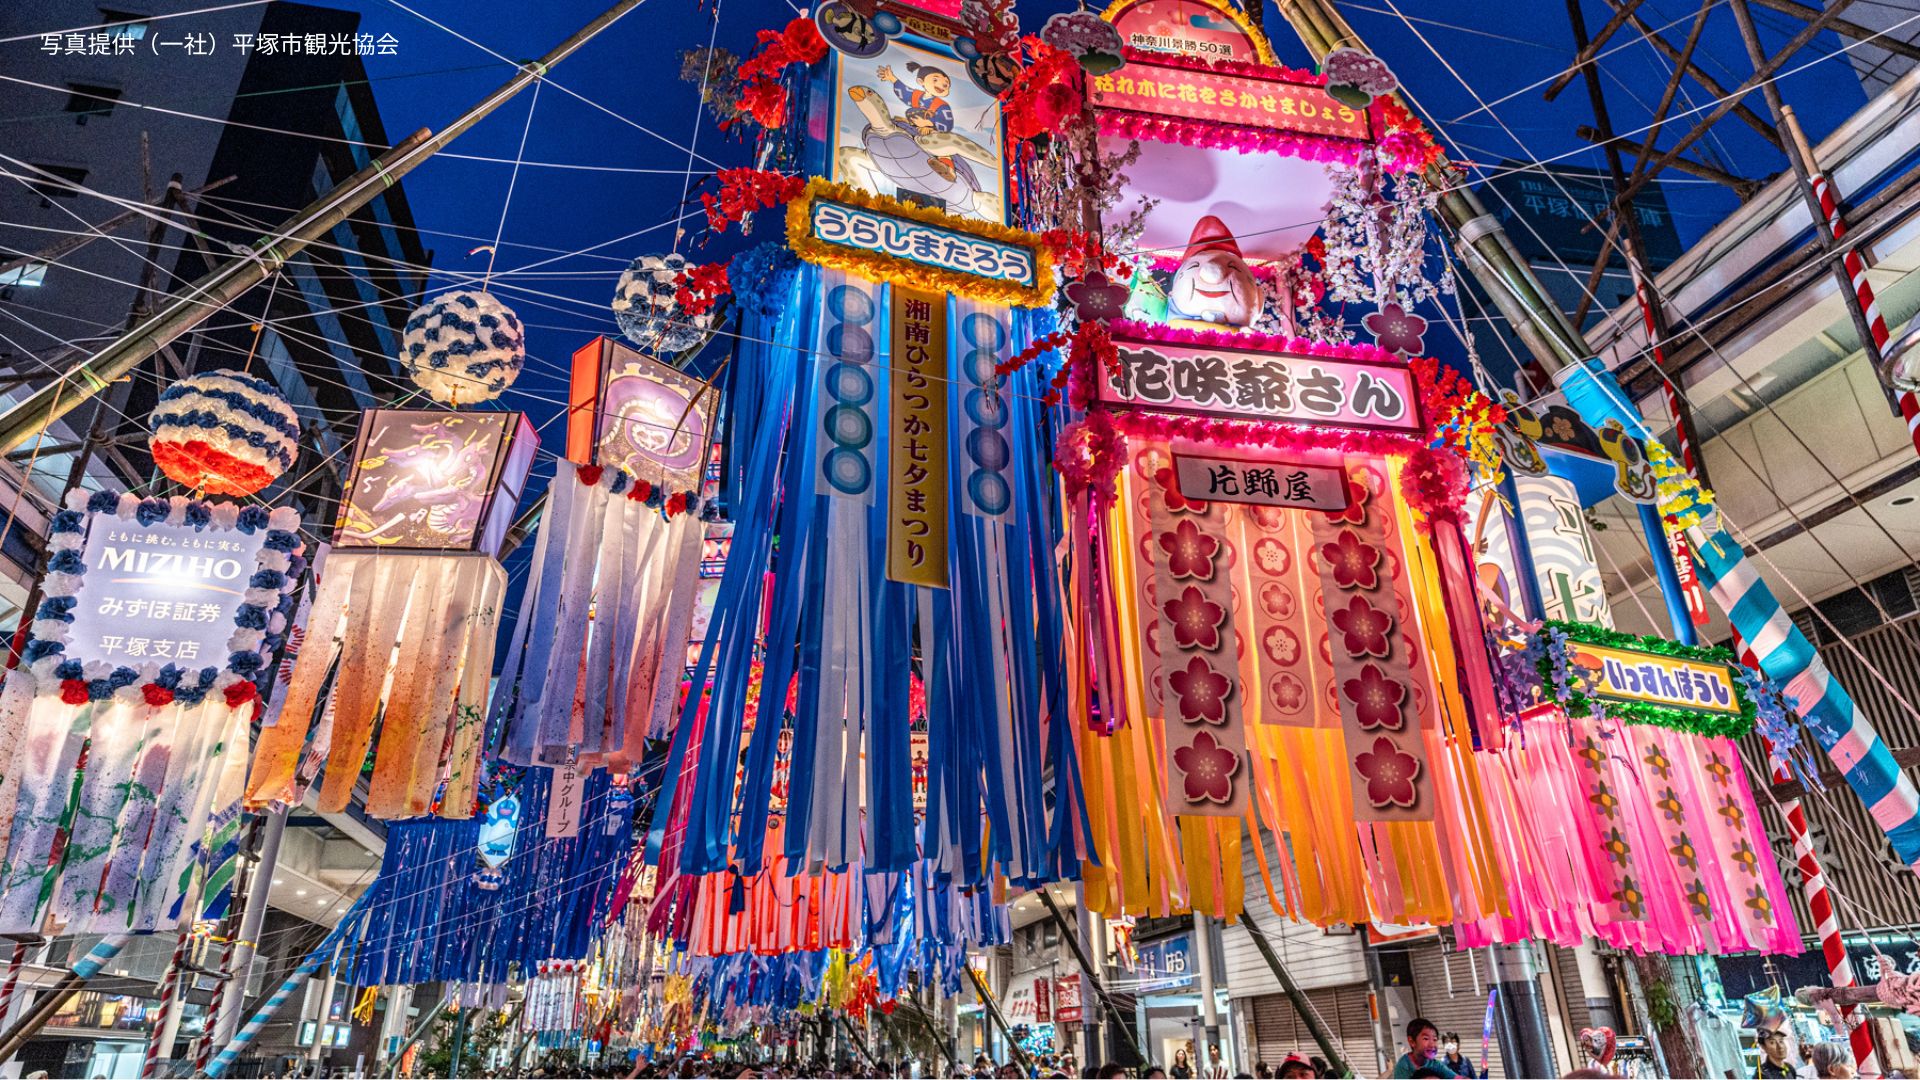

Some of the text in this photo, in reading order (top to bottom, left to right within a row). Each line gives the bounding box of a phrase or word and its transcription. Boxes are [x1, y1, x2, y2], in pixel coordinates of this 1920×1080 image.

[1131, 34, 1232, 55] 神奈川景勝50選
[819, 209, 1029, 280] うらしまたろう
[1111, 348, 1405, 421] 花咲爺さん
[902, 298, 931, 567] 湘南ひらつか七夕まつり
[1208, 465, 1316, 503] 片野屋
[108, 531, 246, 553] ともに挑む。ともに実る。
[98, 547, 241, 580] MIZUHO
[99, 597, 221, 623] みずほ証券
[100, 636, 200, 659] 平塚支店
[1606, 659, 1729, 705] いっすんぼうし
